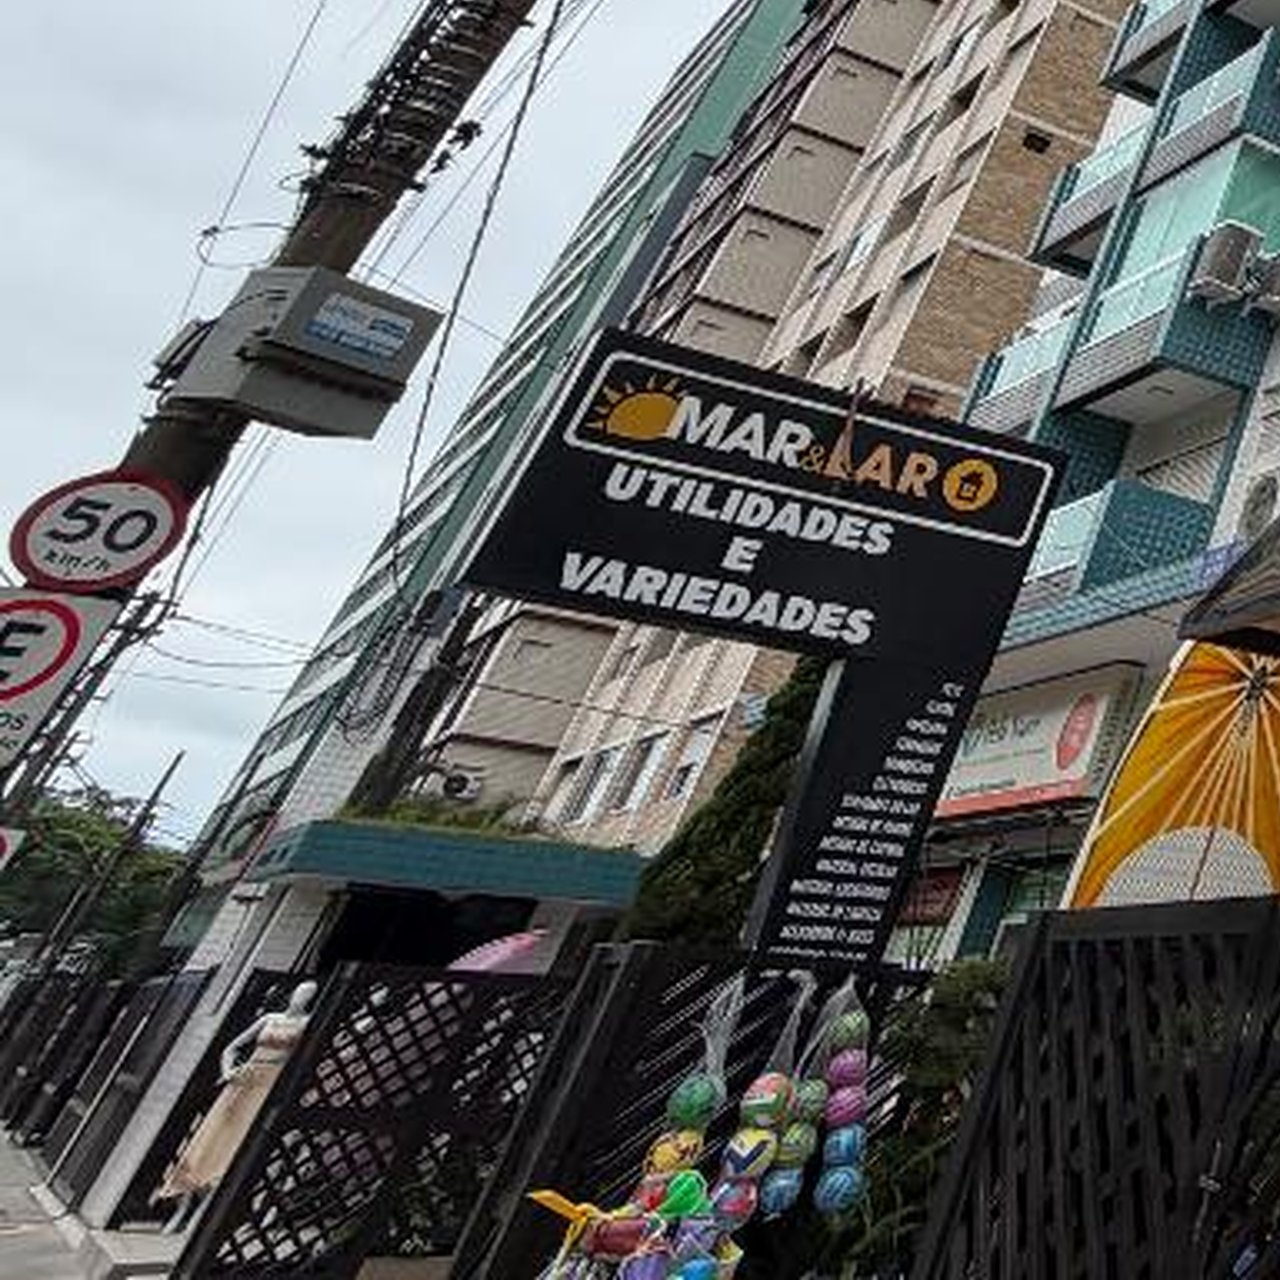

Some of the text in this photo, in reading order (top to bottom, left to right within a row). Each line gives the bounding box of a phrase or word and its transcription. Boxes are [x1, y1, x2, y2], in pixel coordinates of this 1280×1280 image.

[44, 496, 159, 554] 50
[605, 465, 894, 557] UTILIDADES
[722, 536, 758, 573] E
[559, 551, 876, 645] VARIEDADES
